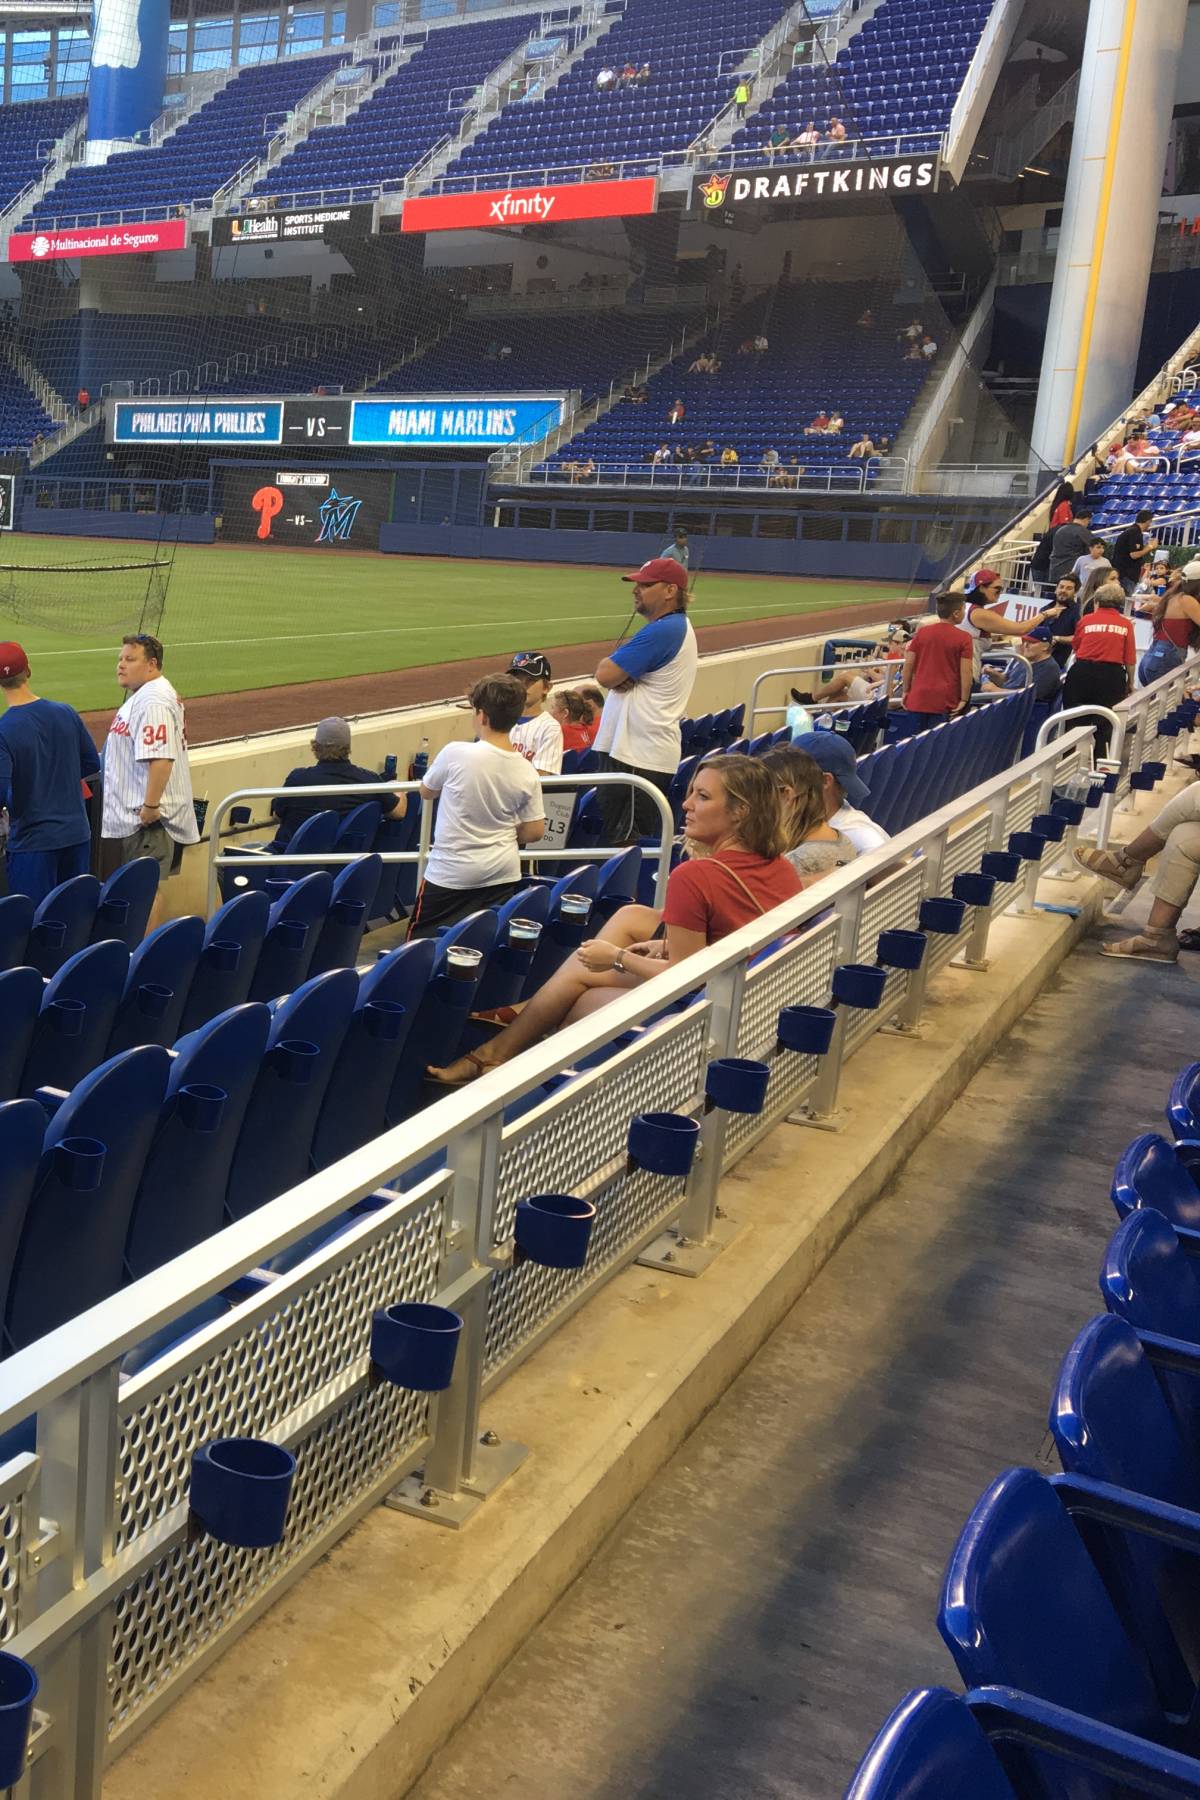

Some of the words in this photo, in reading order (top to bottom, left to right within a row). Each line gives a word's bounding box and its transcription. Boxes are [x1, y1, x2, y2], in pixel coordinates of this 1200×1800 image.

[734, 163, 933, 201] DRAFTKINGS
[284, 213, 313, 225] SPORTS
[315, 210, 351, 222] MEDICINE
[489, 193, 555, 221] xfinity
[283, 224, 324, 236] INSTITUTE
[51, 235, 109, 251] Multinacional
[110, 234, 122, 246] de
[123, 232, 159, 248] Seguros
[132, 412, 210, 433] PHILADELPHIA
[214, 412, 266, 433] PHILLIES
[388, 409, 436, 436] MIAMI
[441, 408, 517, 436] MARLINS
[1083, 624, 1108, 635] EVENT
[142, 723, 168, 746] 34
